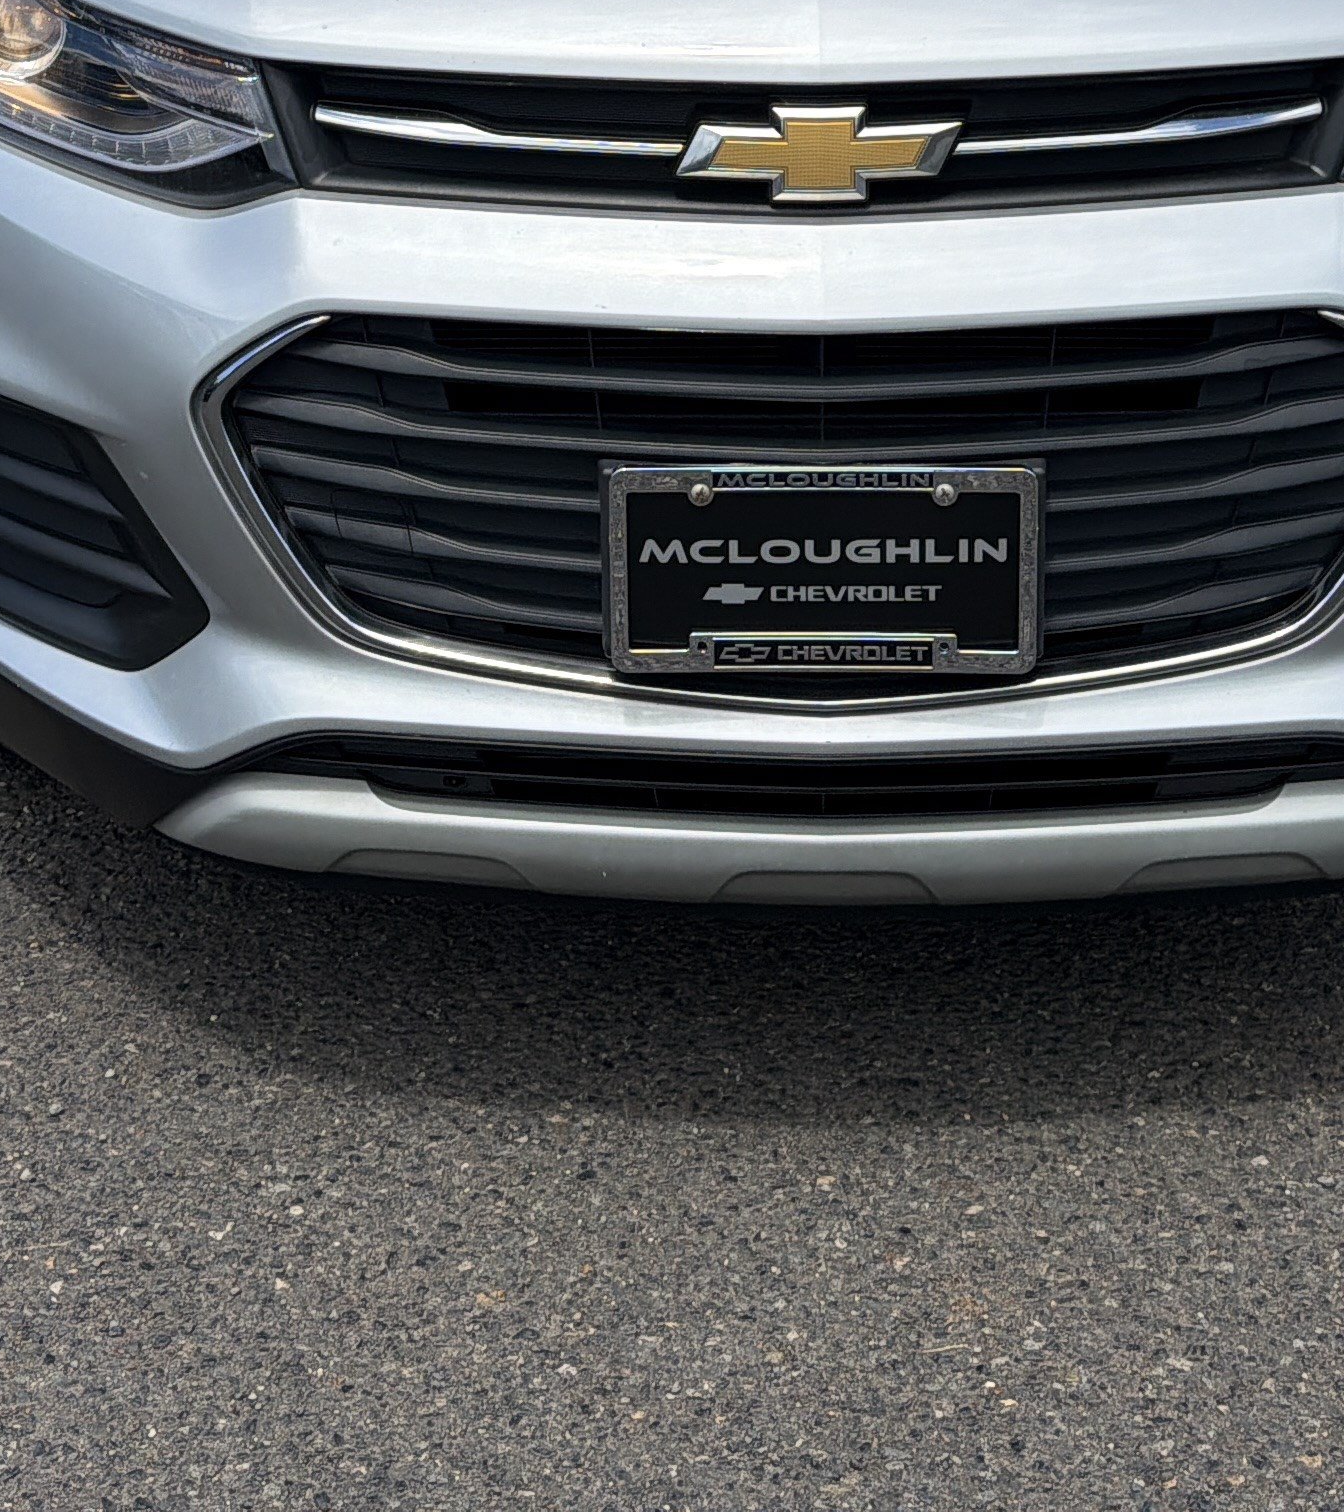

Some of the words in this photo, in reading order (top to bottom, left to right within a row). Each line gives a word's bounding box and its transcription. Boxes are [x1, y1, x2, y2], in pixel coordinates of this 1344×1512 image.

[717, 472, 931, 489] MCLOUGHLIN
[639, 538, 1009, 565] MCLOUGHLIN
[769, 584, 943, 603] CHEVROLET
[777, 645, 930, 661] CHEVROLET
